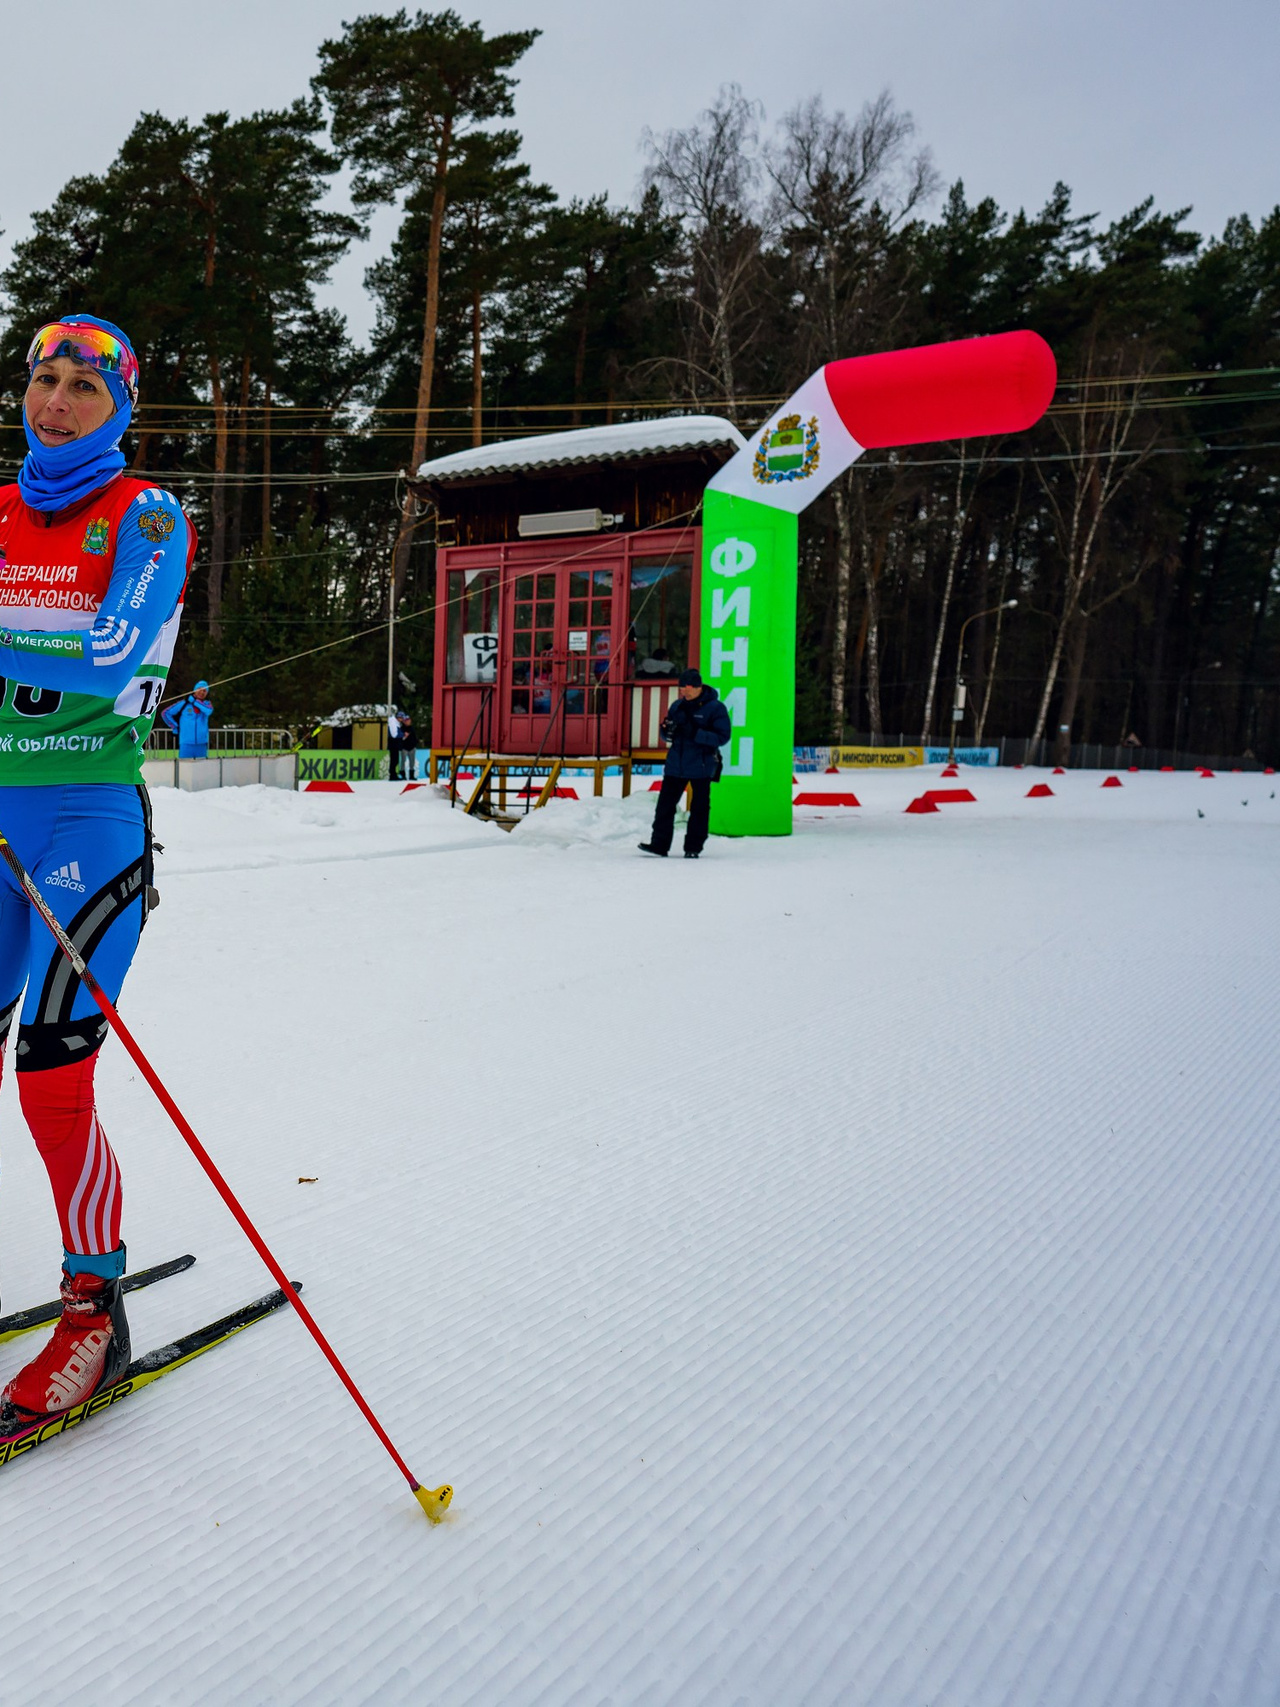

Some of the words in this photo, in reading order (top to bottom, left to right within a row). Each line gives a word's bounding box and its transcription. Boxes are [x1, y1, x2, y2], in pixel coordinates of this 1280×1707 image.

[129, 549, 166, 610] Webasto
[36, 589, 98, 611] ГОНОК
[300, 757, 376, 780] ЖИЗНИ
[45, 876, 86, 894] adidas
